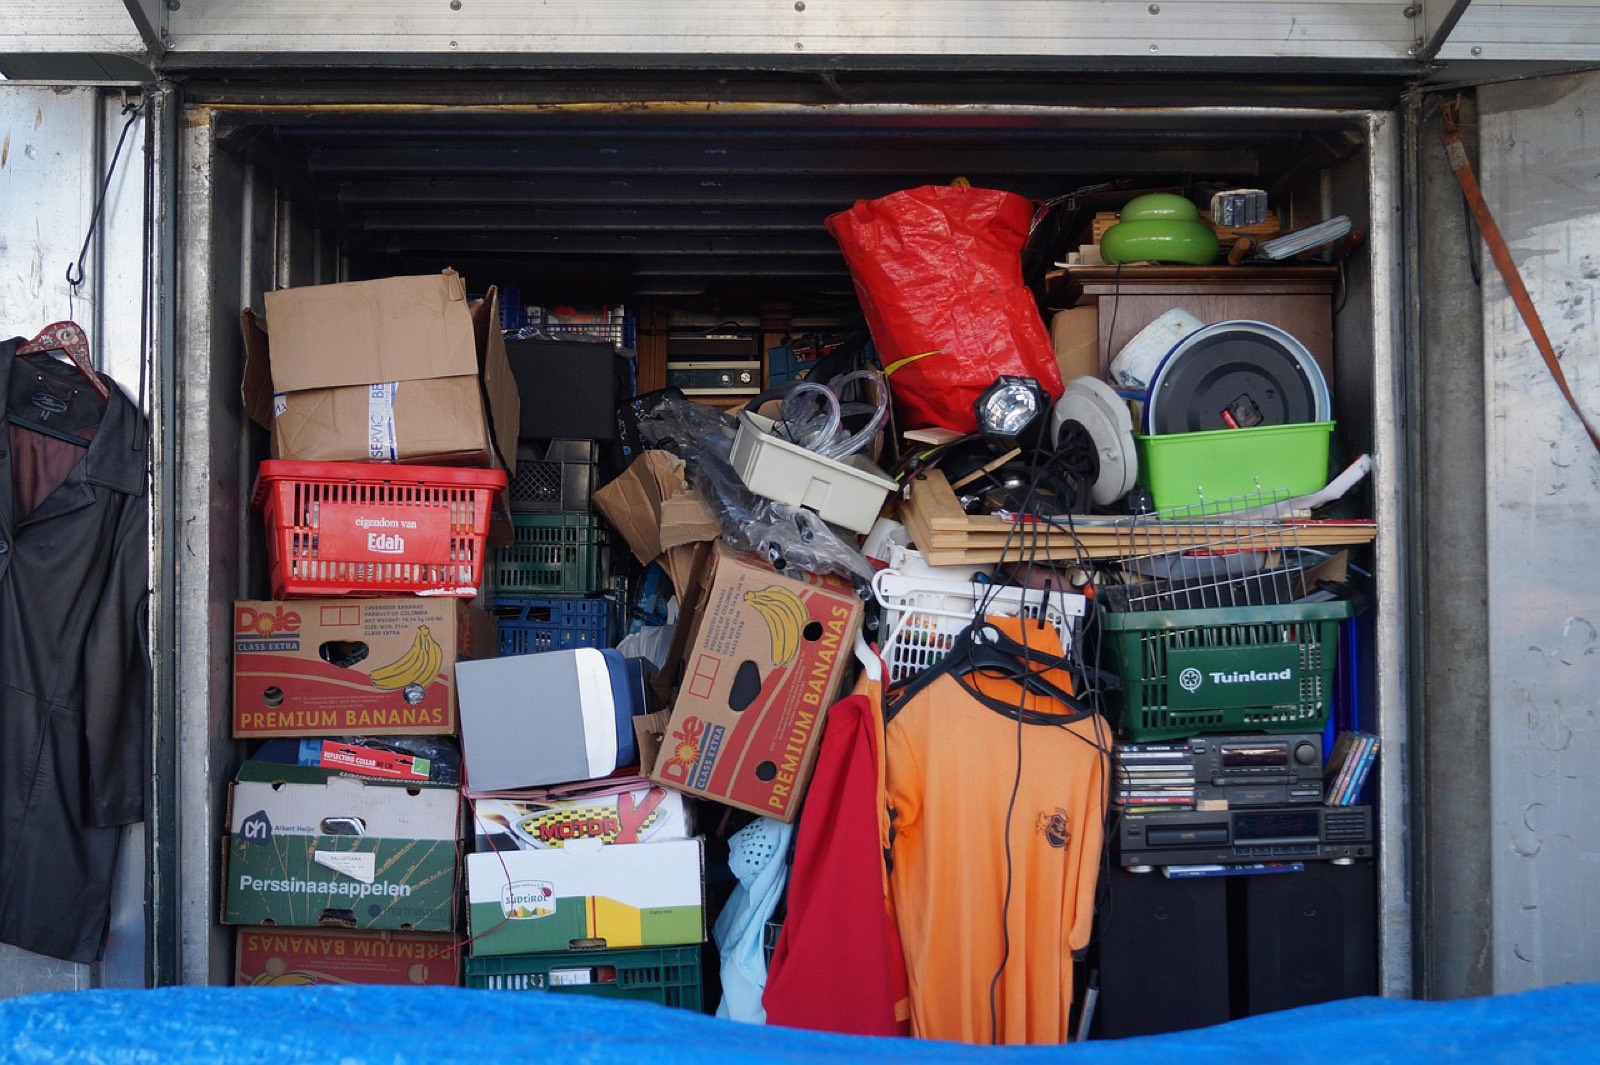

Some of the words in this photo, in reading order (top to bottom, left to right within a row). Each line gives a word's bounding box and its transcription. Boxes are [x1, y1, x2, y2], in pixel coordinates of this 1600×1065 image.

[355, 516, 399, 529] eigendom
[400, 520, 417, 529] van
[368, 533, 405, 552] Edah
[235, 606, 302, 636] Dole
[237, 642, 267, 651] CLASS
[268, 641, 298, 651] EXTRA
[1208, 668, 1291, 684] Tuinland
[240, 710, 338, 728] PREMIUM
[345, 708, 443, 726] BANANAS
[768, 711, 815, 810] PREMIUM
[803, 606, 849, 706] BANANAS
[324, 751, 355, 763] REFLECTING
[356, 758, 376, 767] COLLAR
[660, 716, 705, 784] Dole
[696, 759, 711, 788] CLASS
[707, 726, 723, 757] EXTRA
[540, 817, 620, 841] MOTOR
[240, 875, 412, 898] Perssinaasappelen
[248, 935, 346, 955] BANANAS
[353, 940, 451, 960] PREMIUM
